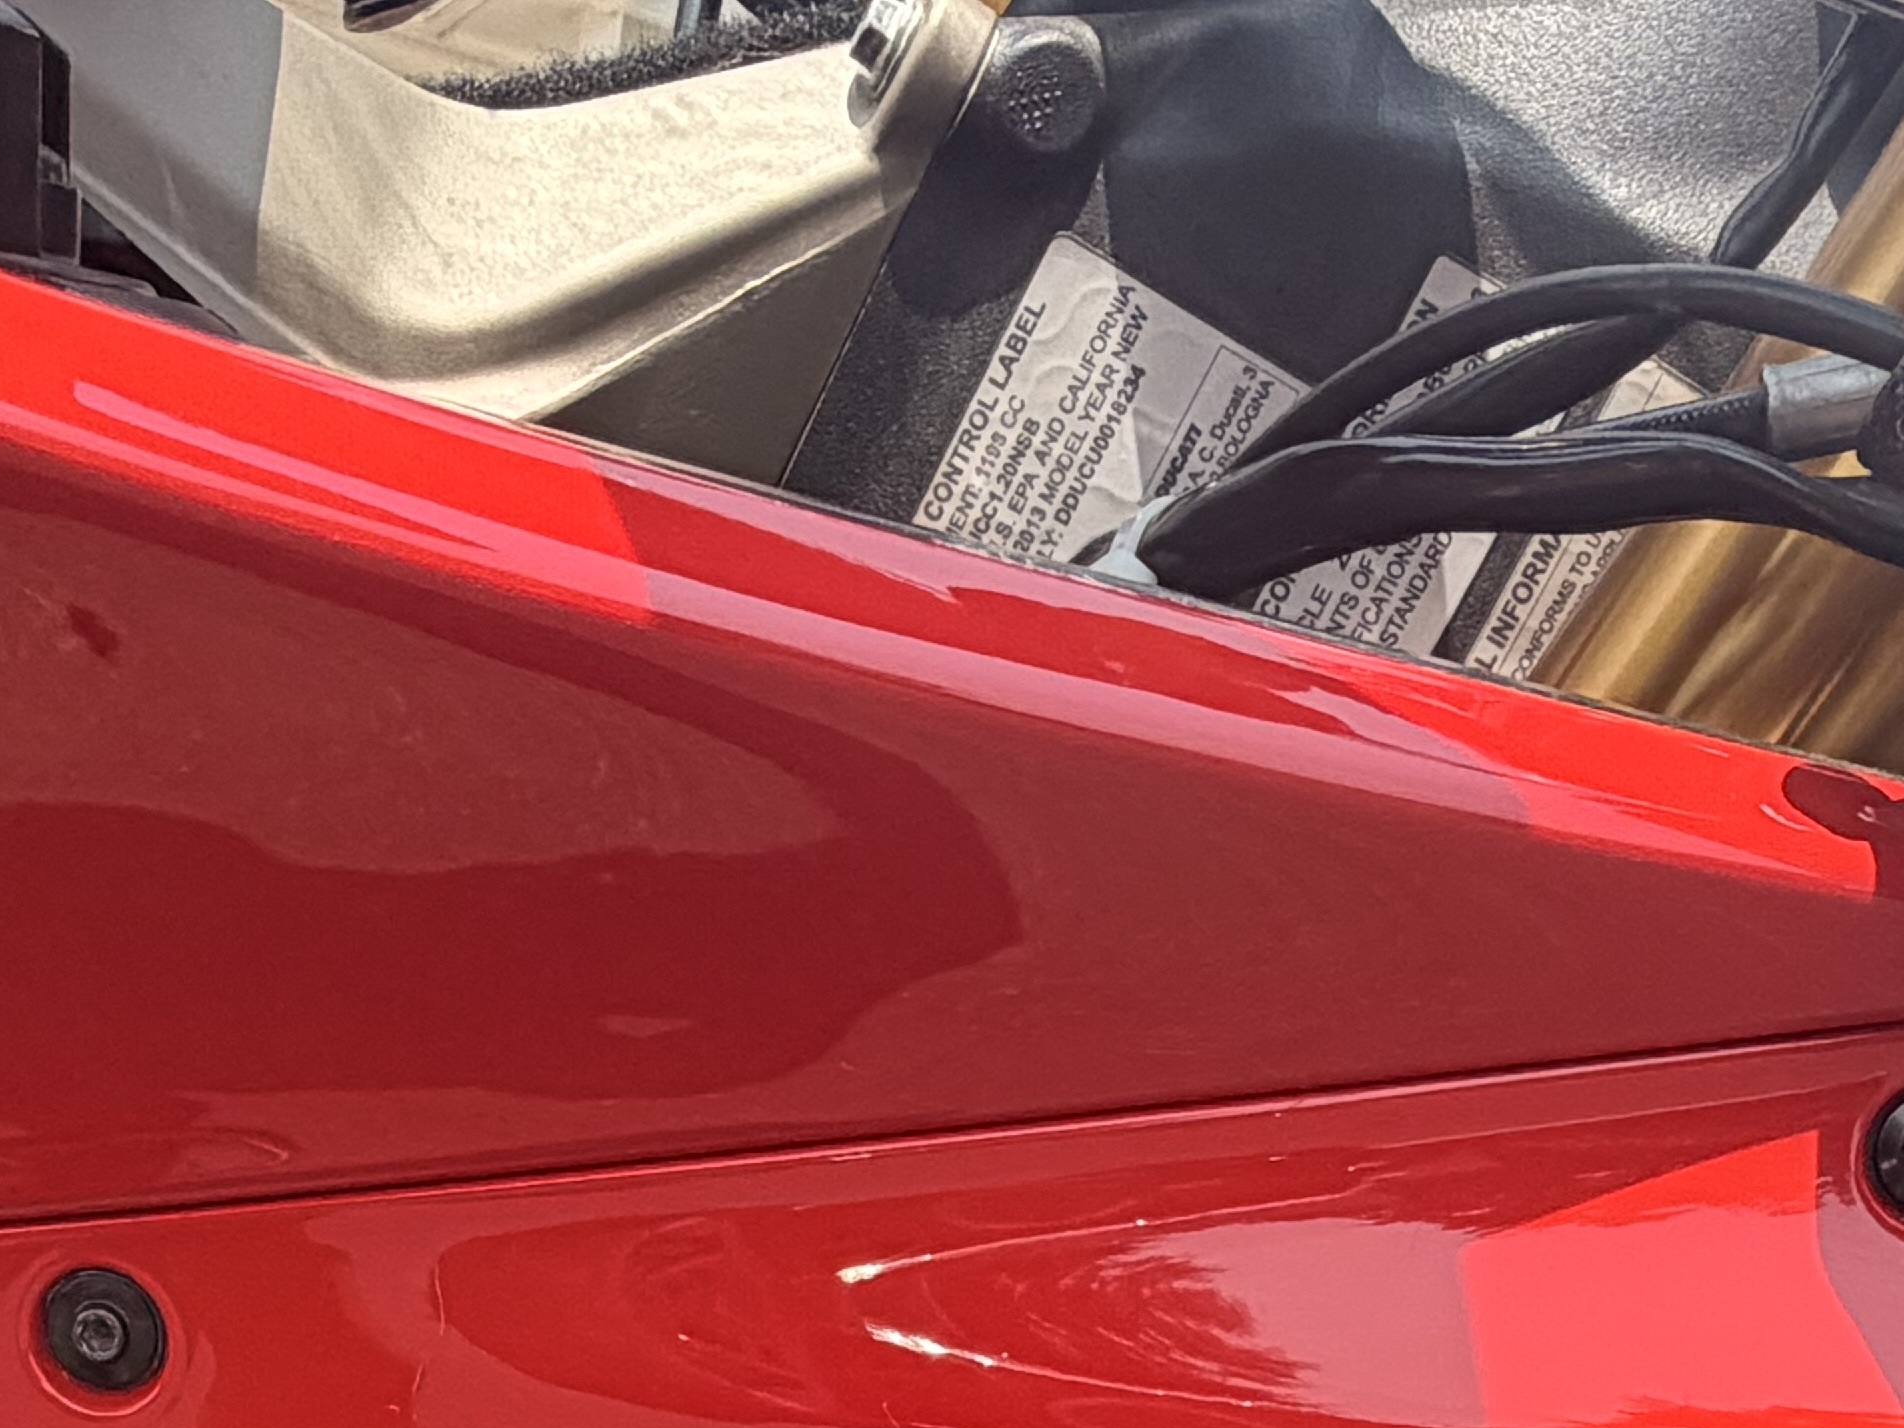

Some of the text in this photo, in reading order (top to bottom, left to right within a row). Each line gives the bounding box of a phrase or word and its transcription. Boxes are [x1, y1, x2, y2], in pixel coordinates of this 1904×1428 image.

[923, 302, 1047, 522] CONTROL LABEL
[1000, 394, 1026, 431] CC
[1007, 470, 1040, 516] EPA
[1034, 416, 1066, 466] AND
[1058, 284, 1136, 414] CALIFORNIA
[1013, 304, 1150, 552] 2013 MODEL YEAR NEW
[1154, 422, 1202, 498] DUCATI
[1350, 553, 1376, 590] OF
[1571, 544, 1594, 578] TO
